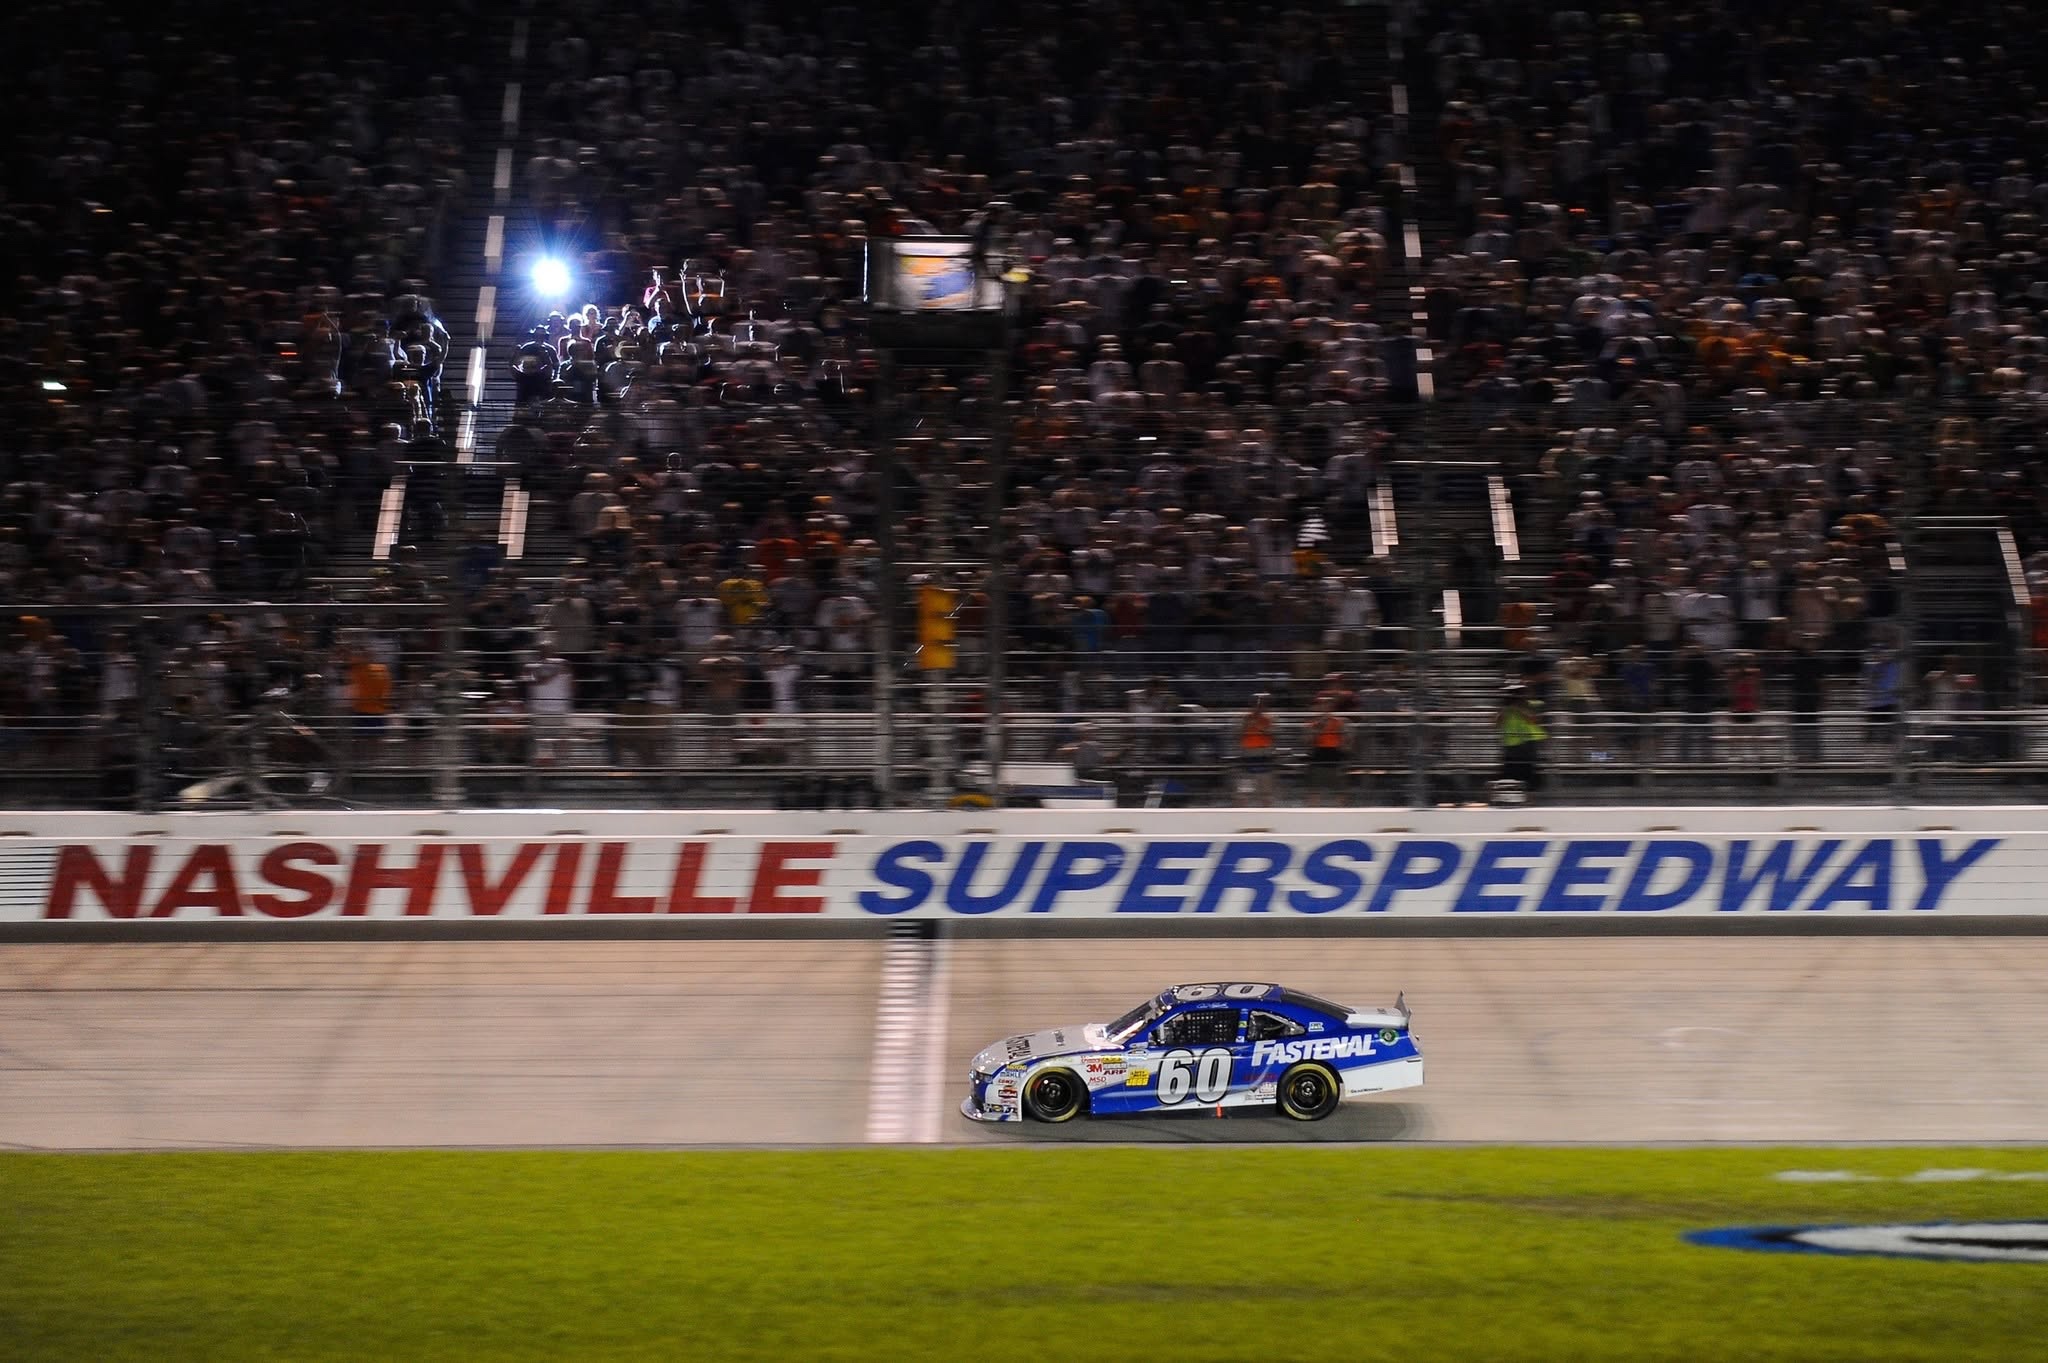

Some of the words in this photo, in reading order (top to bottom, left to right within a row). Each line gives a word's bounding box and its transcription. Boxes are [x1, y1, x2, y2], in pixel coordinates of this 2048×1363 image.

[44, 842, 836, 920] NASHVILLE
[859, 838, 2002, 915] SUPERSPEEDWAY
[1086, 1064, 1102, 1073] 3M
[1251, 1034, 1376, 1066] FASTENAL
[1157, 1047, 1231, 1105] 60
